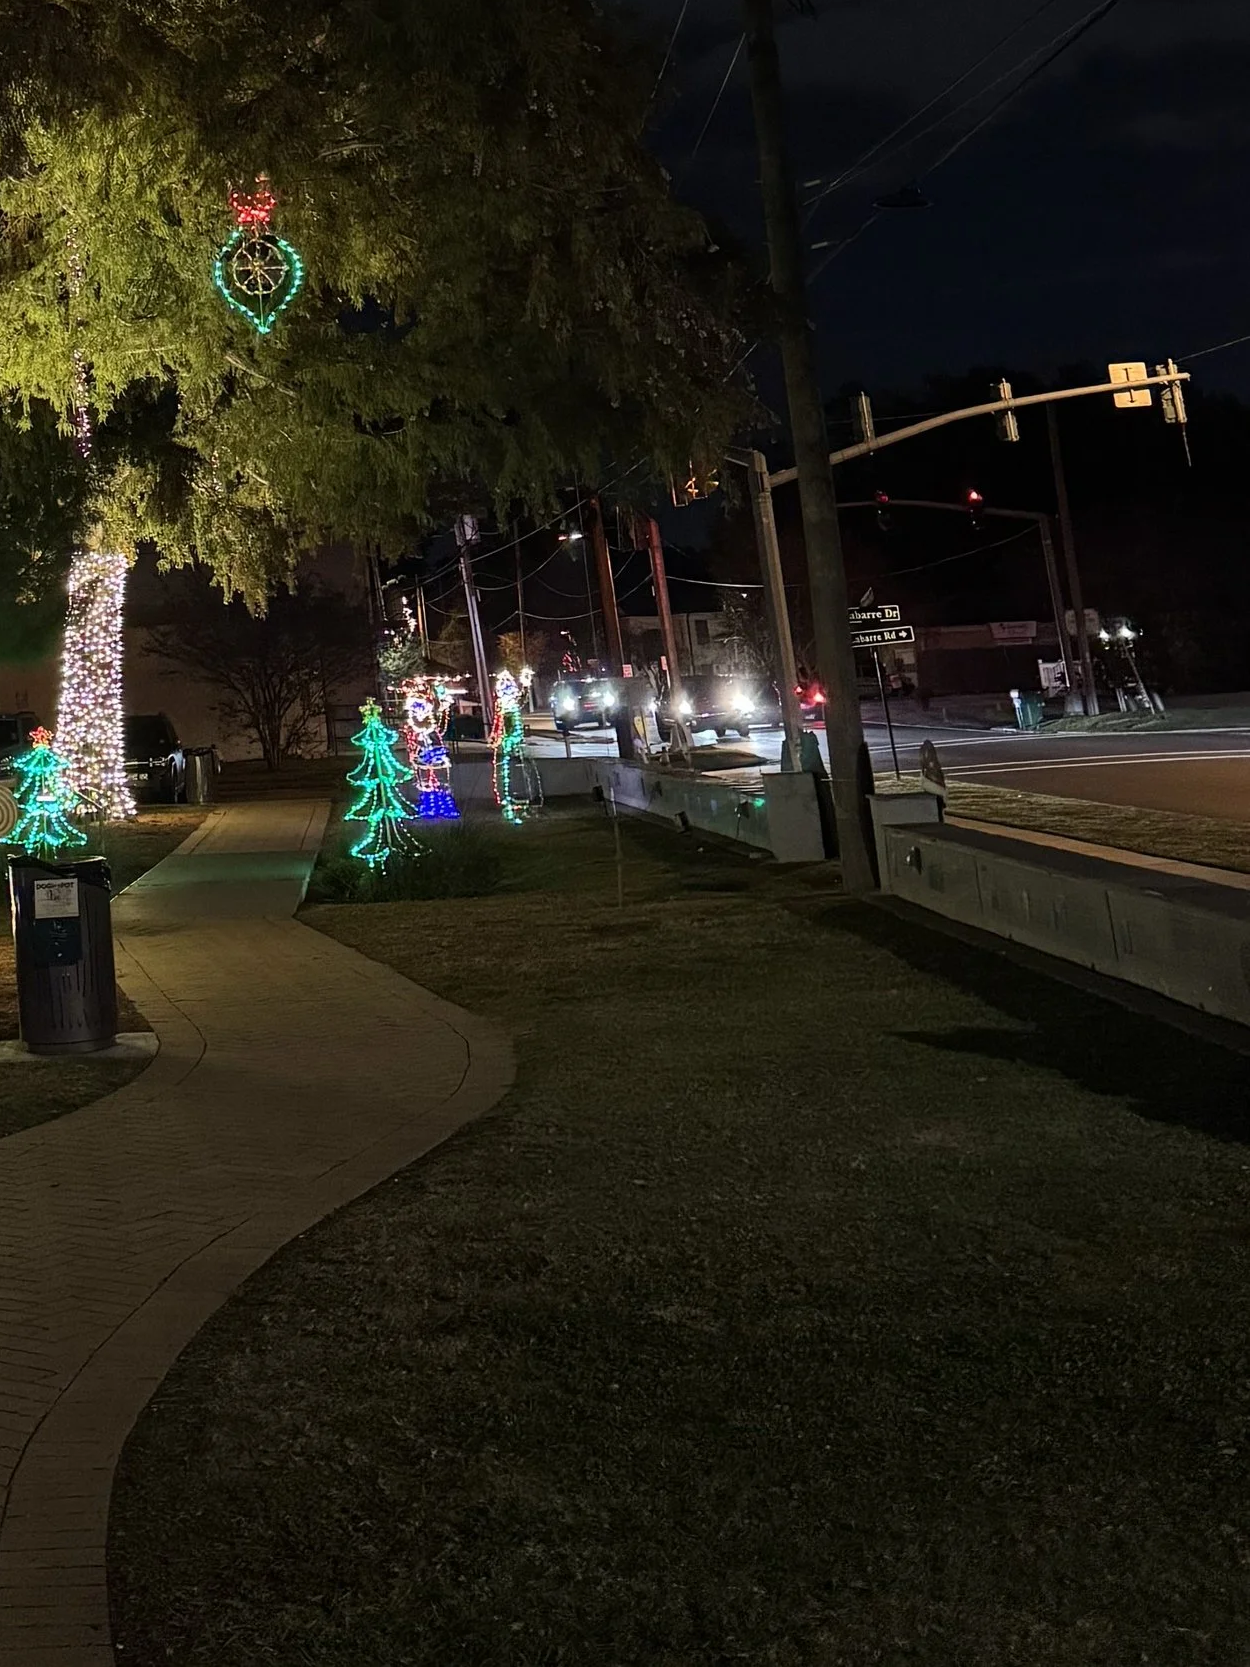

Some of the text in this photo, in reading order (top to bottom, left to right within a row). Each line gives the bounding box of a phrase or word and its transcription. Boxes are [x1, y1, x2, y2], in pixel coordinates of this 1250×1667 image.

[848, 609, 898, 620] abarre Dr
[851, 631, 896, 643] abarre Rd
